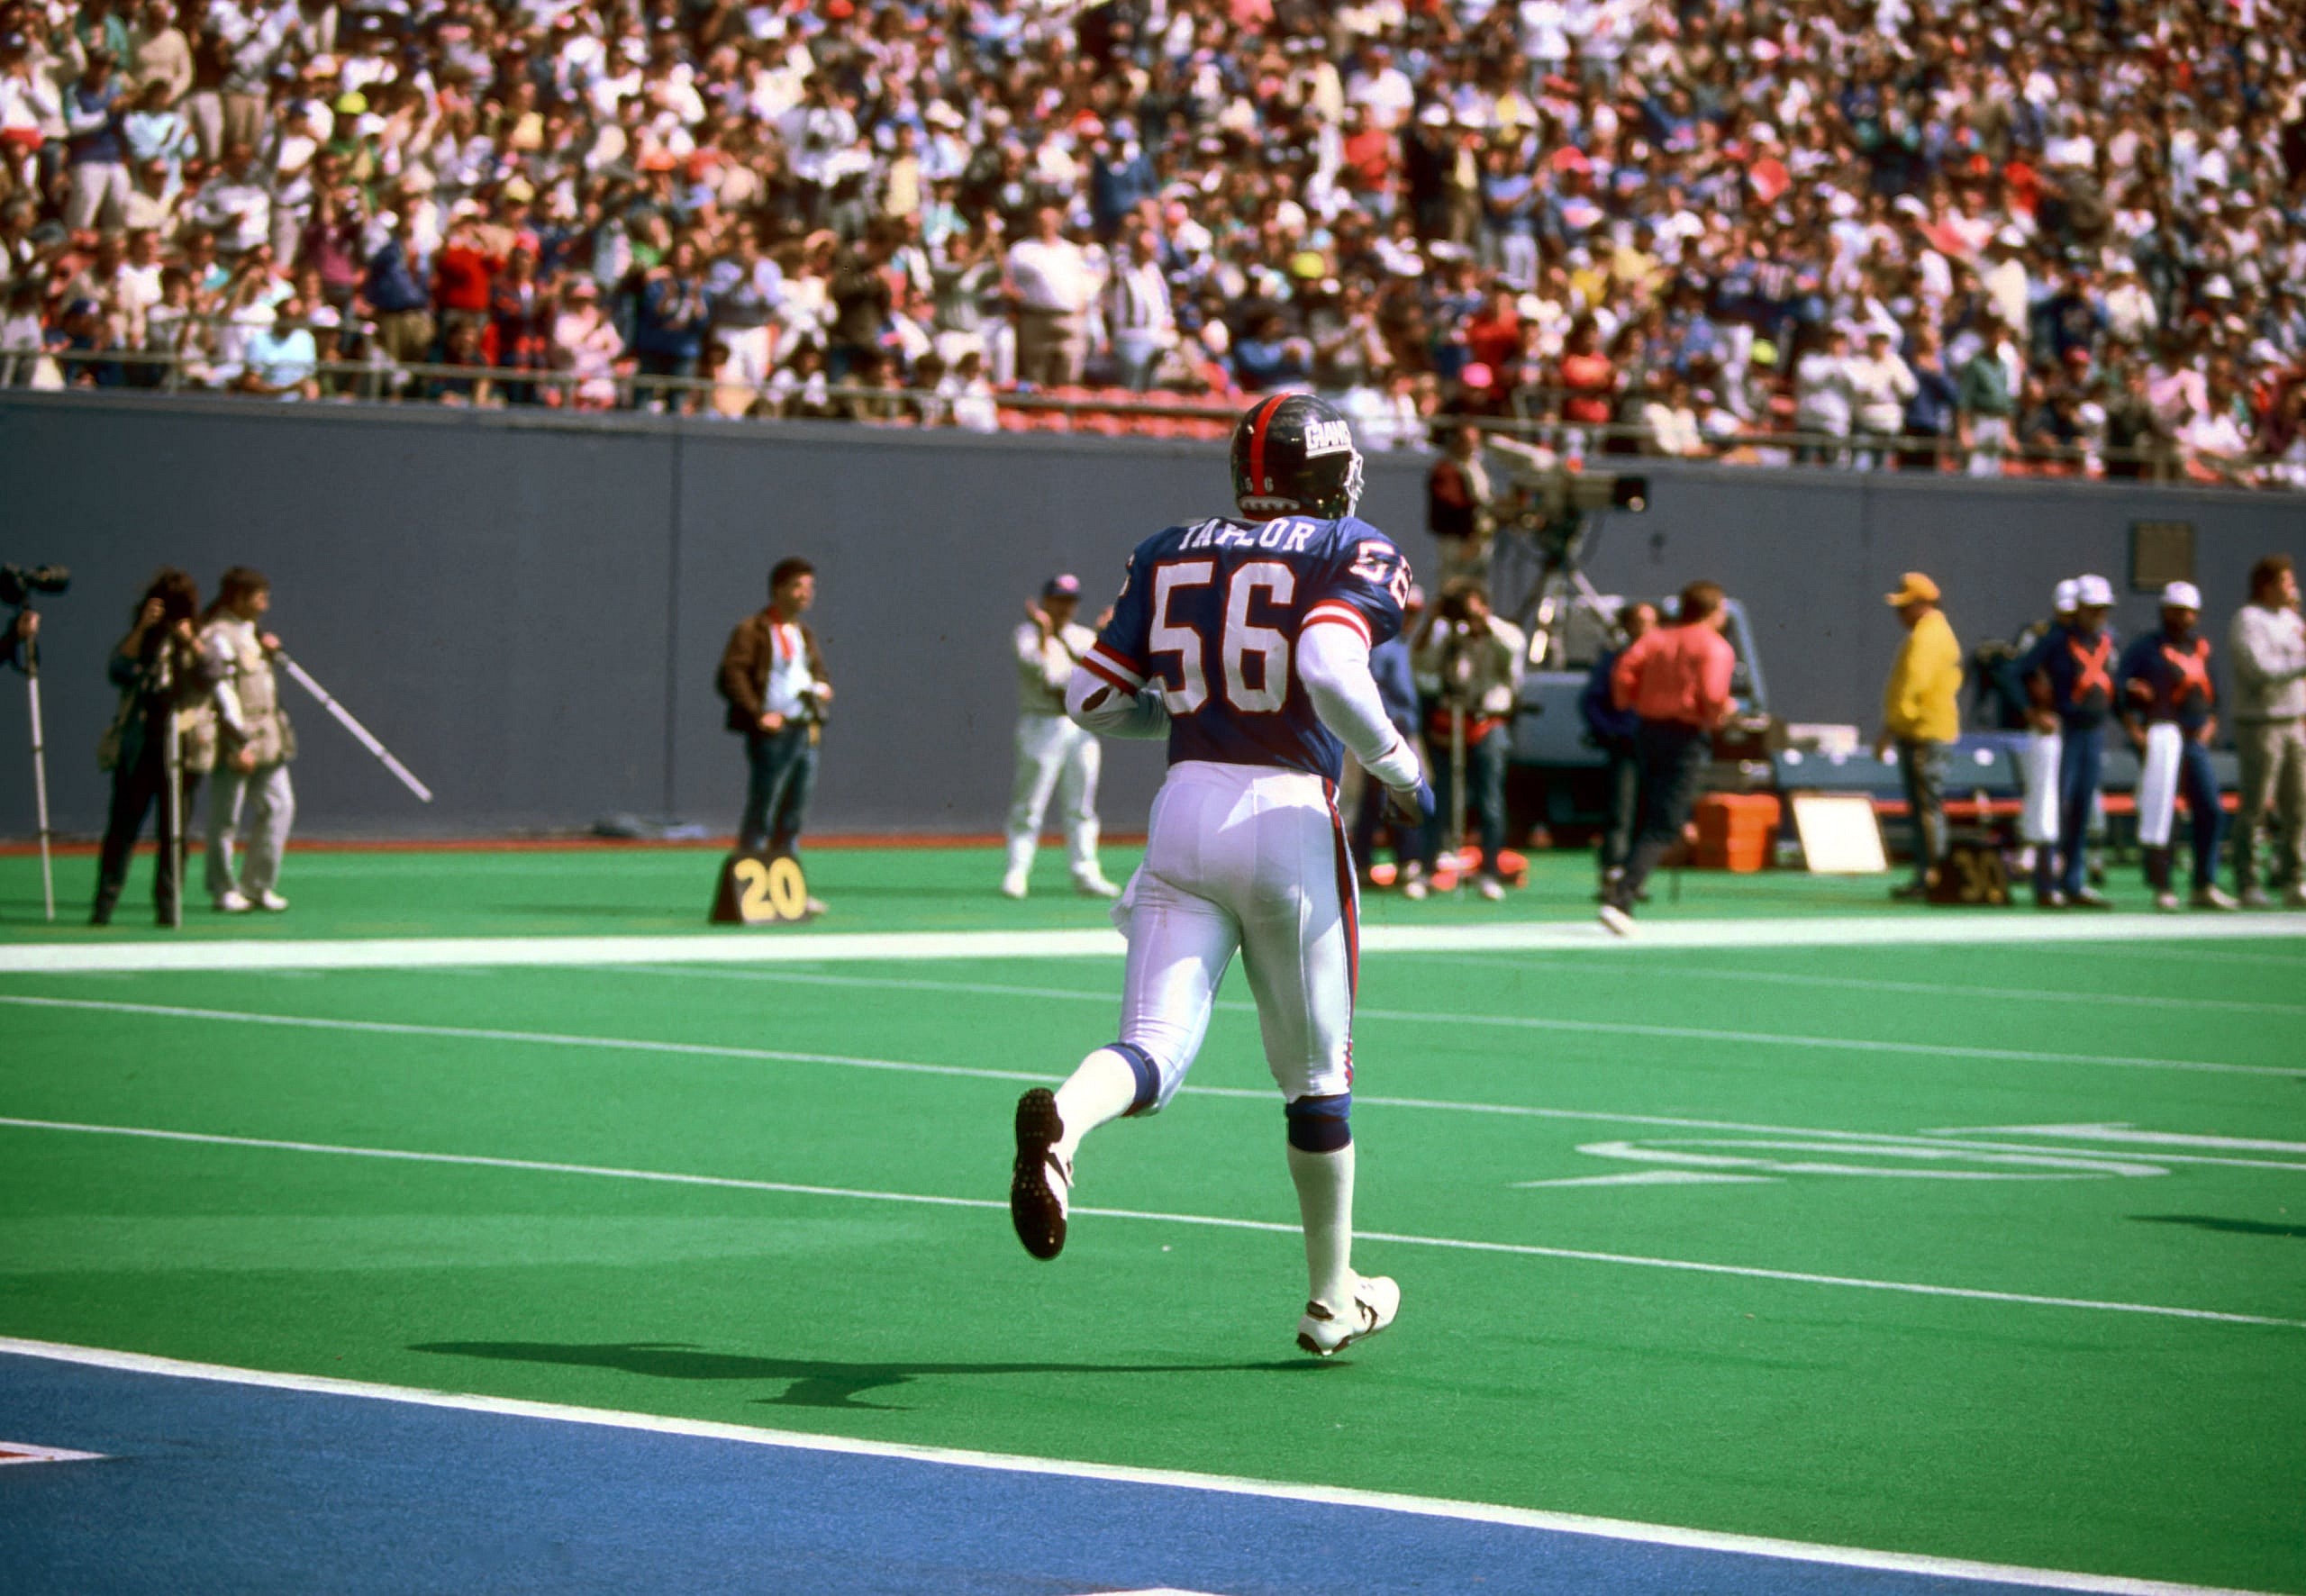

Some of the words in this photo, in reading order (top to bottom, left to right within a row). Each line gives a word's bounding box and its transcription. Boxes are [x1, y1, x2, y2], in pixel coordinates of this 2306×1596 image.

[1264, 476, 1274, 492] 6
[1178, 517, 1316, 551] TAYLOR
[1348, 540, 1412, 610] 56
[1148, 559, 1297, 716] 56
[734, 857, 808, 924] 20
